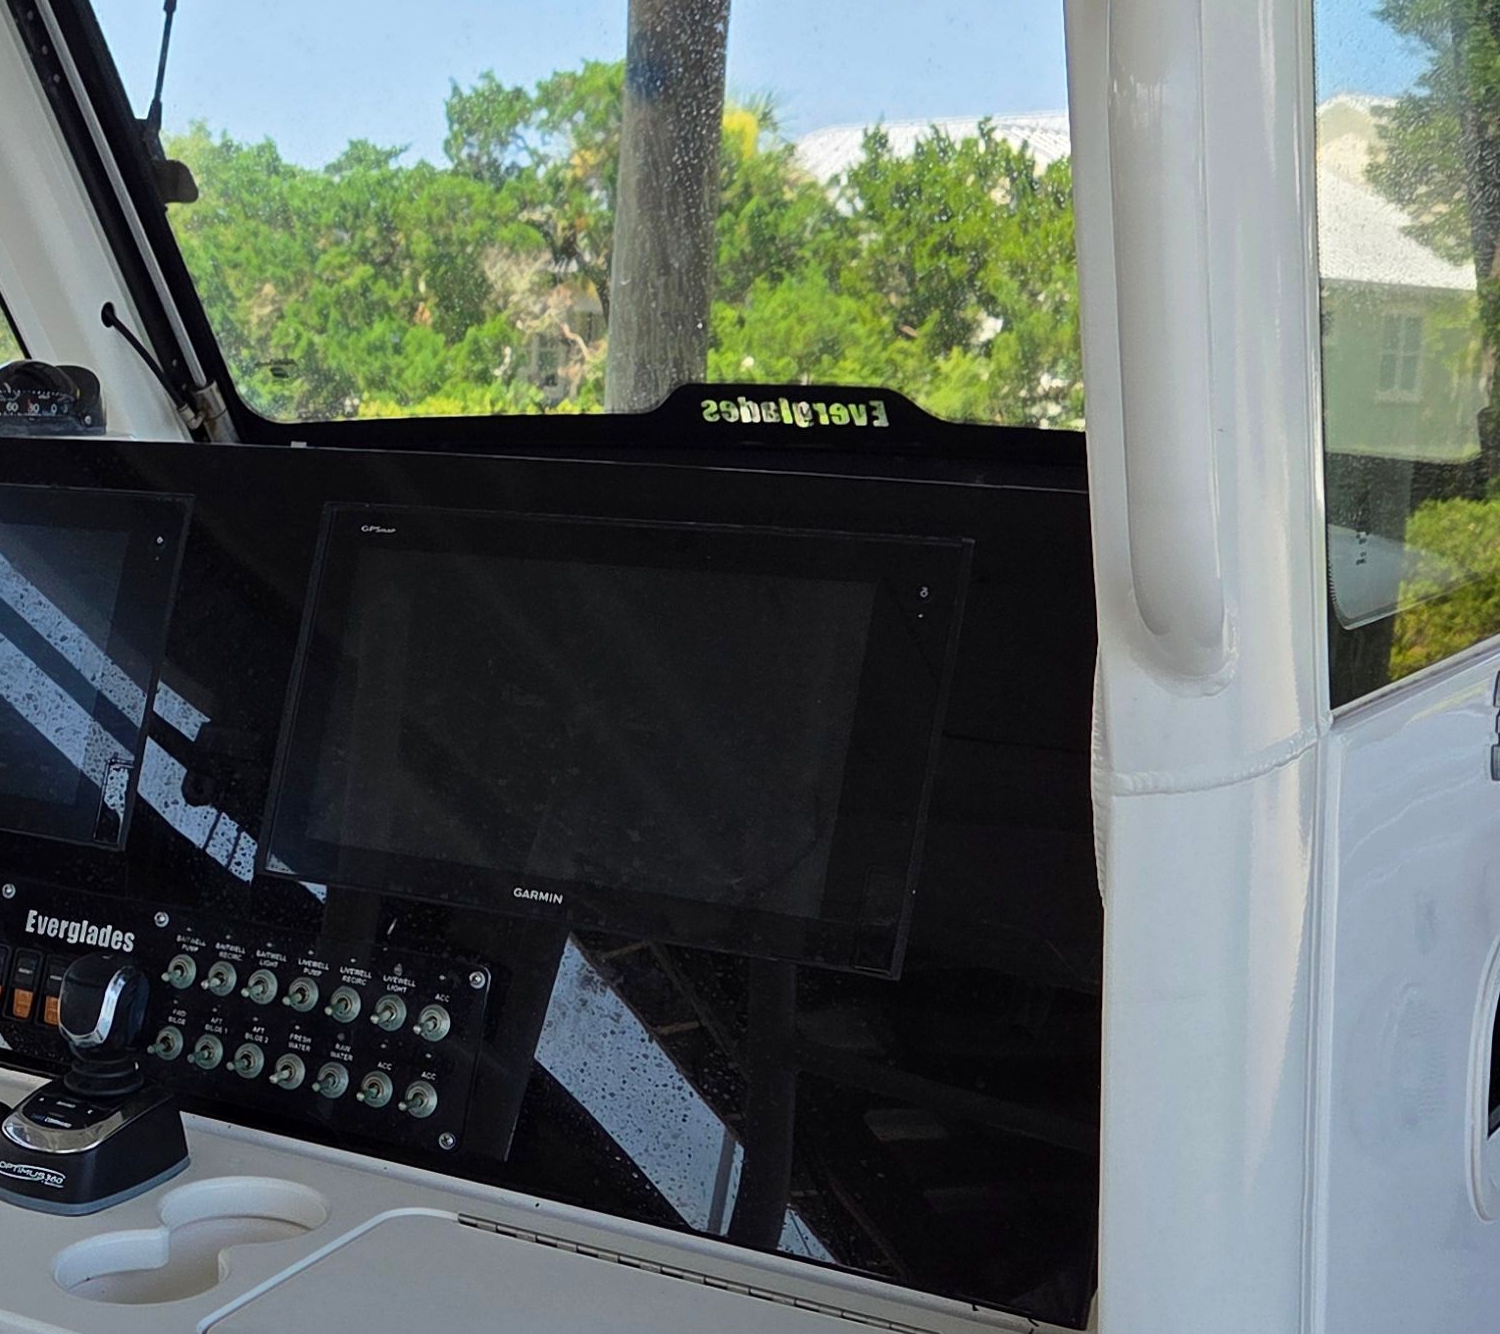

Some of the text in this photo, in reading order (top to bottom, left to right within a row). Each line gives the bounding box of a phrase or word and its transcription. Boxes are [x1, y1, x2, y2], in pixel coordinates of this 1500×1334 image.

[6, 401, 19, 413] 60
[513, 887, 564, 905] GARMIN
[25, 909, 135, 953] Everglades
[176, 934, 206, 947] BAITWELL
[181, 943, 199, 953] PUMP
[215, 942, 246, 955] BAITWELL
[218, 951, 244, 962] RECIRC
[256, 949, 287, 962] BAITWELL
[259, 959, 279, 968] LIGHT
[298, 957, 330, 971] LIVEWELL
[303, 967, 323, 977] PUMP
[340, 966, 372, 979] LIVEWELL
[342, 975, 368, 986] RECIRC
[383, 974, 416, 988] LIVEWELL
[386, 983, 408, 994] LIGHT
[434, 993, 450, 1003] ACC
[168, 1015, 187, 1026] BILGE
[210, 1017, 223, 1025] AFT
[204, 1023, 224, 1034] BILGE
[252, 1026, 265, 1034] AFT
[244, 1032, 264, 1043] BILGE
[289, 1033, 312, 1044] FRESH
[288, 1041, 312, 1052] WATER
[335, 1043, 352, 1053] RAW
[330, 1050, 354, 1062] WATER
[377, 1061, 393, 1071] ACC
[421, 1071, 437, 1081] ACC
